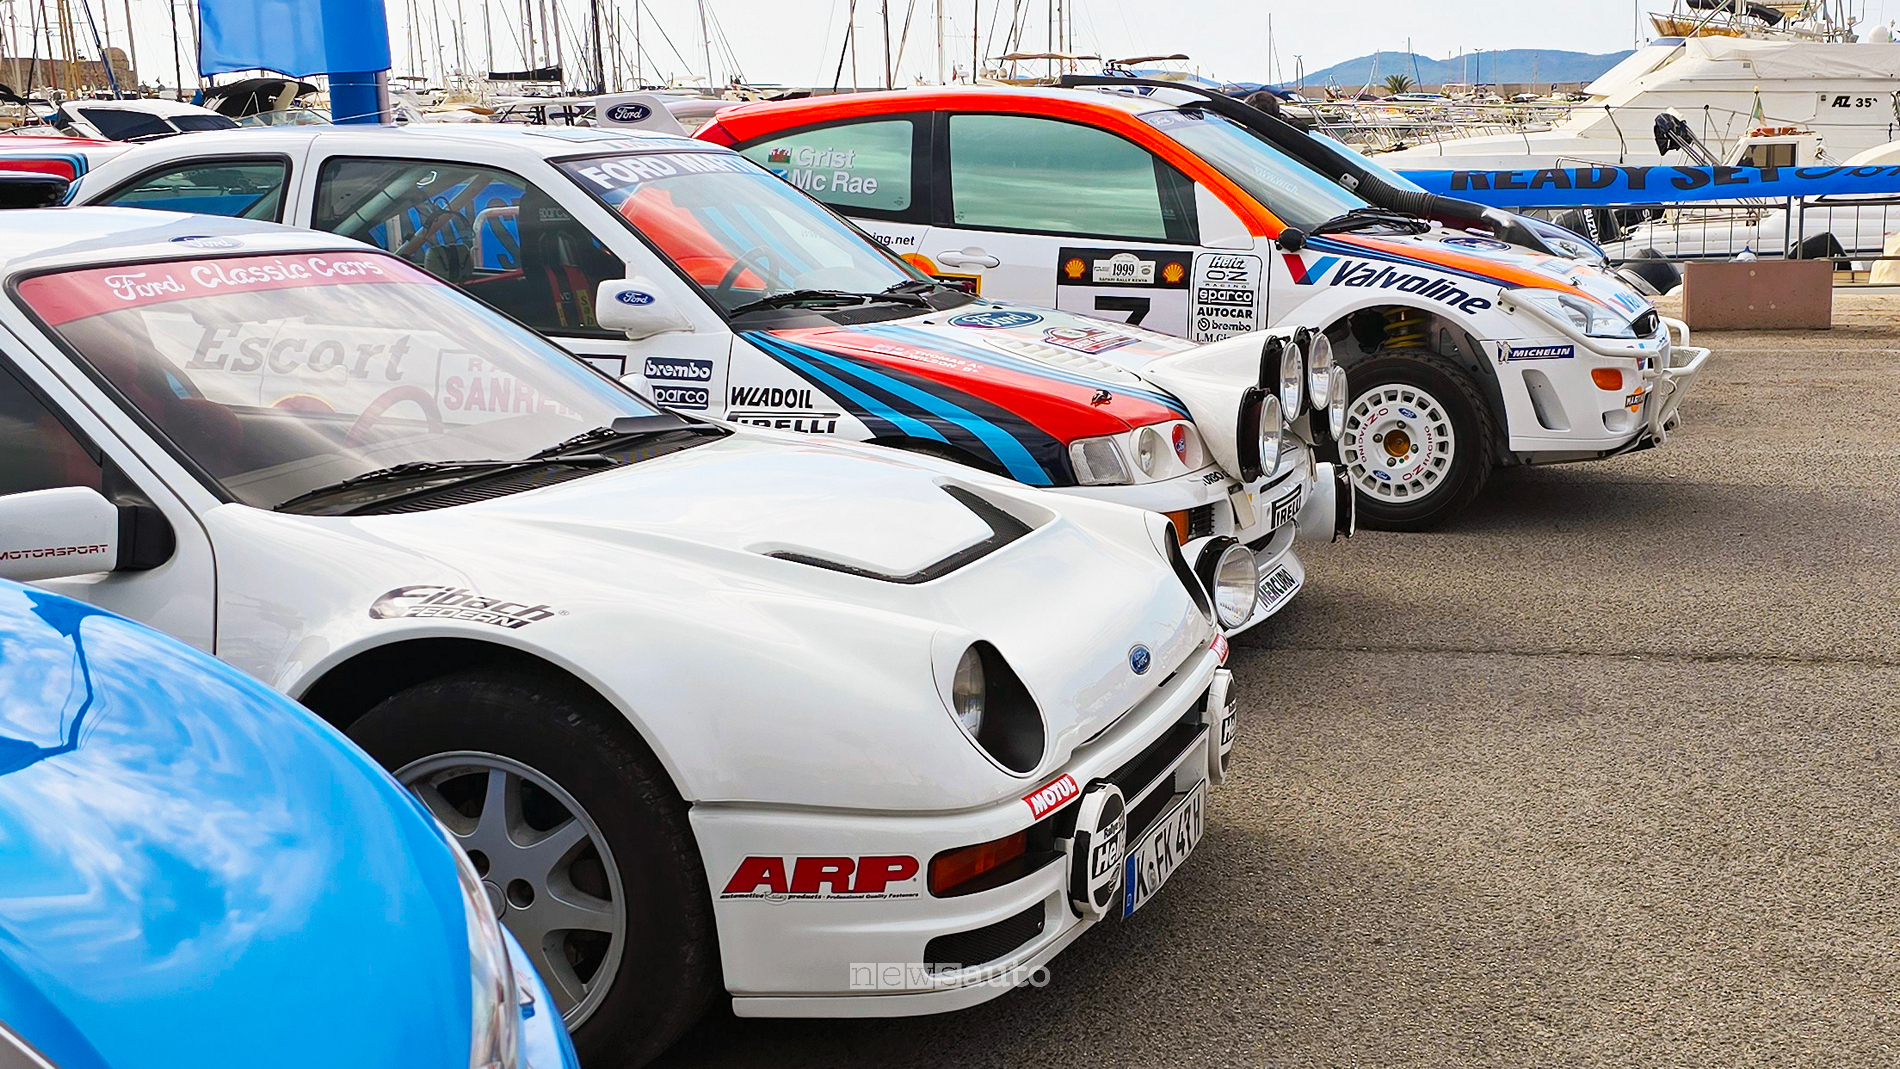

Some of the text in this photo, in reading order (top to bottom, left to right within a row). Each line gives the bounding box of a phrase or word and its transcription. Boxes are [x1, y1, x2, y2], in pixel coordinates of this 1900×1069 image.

[1832, 96, 1851, 108] AZ
[614, 106, 642, 119] Ford
[795, 145, 856, 169] Grist
[578, 157, 677, 189] FORD
[791, 169, 878, 194] Mc Rae
[1451, 166, 1651, 190] READY
[872, 232, 915, 246] ing.net
[1112, 262, 1135, 276] 1999
[1208, 256, 1248, 269] Hertz
[104, 256, 384, 300] Ford Classic Cars
[1199, 289, 1253, 303] sparco
[1329, 260, 1492, 315] Valvoline
[622, 291, 649, 304] Ford
[580, 296, 596, 325] Sab
[1094, 296, 1150, 326] 7
[1197, 307, 1253, 319] AUTOCAR
[962, 312, 1031, 328] Ford
[1212, 320, 1252, 332] brembo
[185, 323, 412, 381] Escort
[908, 353, 958, 369] WILSON
[913, 349, 966, 365] THOMAS
[1512, 347, 1571, 357] MICHELIN
[645, 360, 711, 378] brembo
[654, 387, 708, 405] parco
[0, 544, 108, 560] MOTORSPORT
[401, 605, 526, 628] FEDERN
[1030, 775, 1077, 816] MOTUL
[1136, 849, 1149, 905] K
[1154, 821, 1174, 884] FK
[722, 856, 920, 893] ARP
